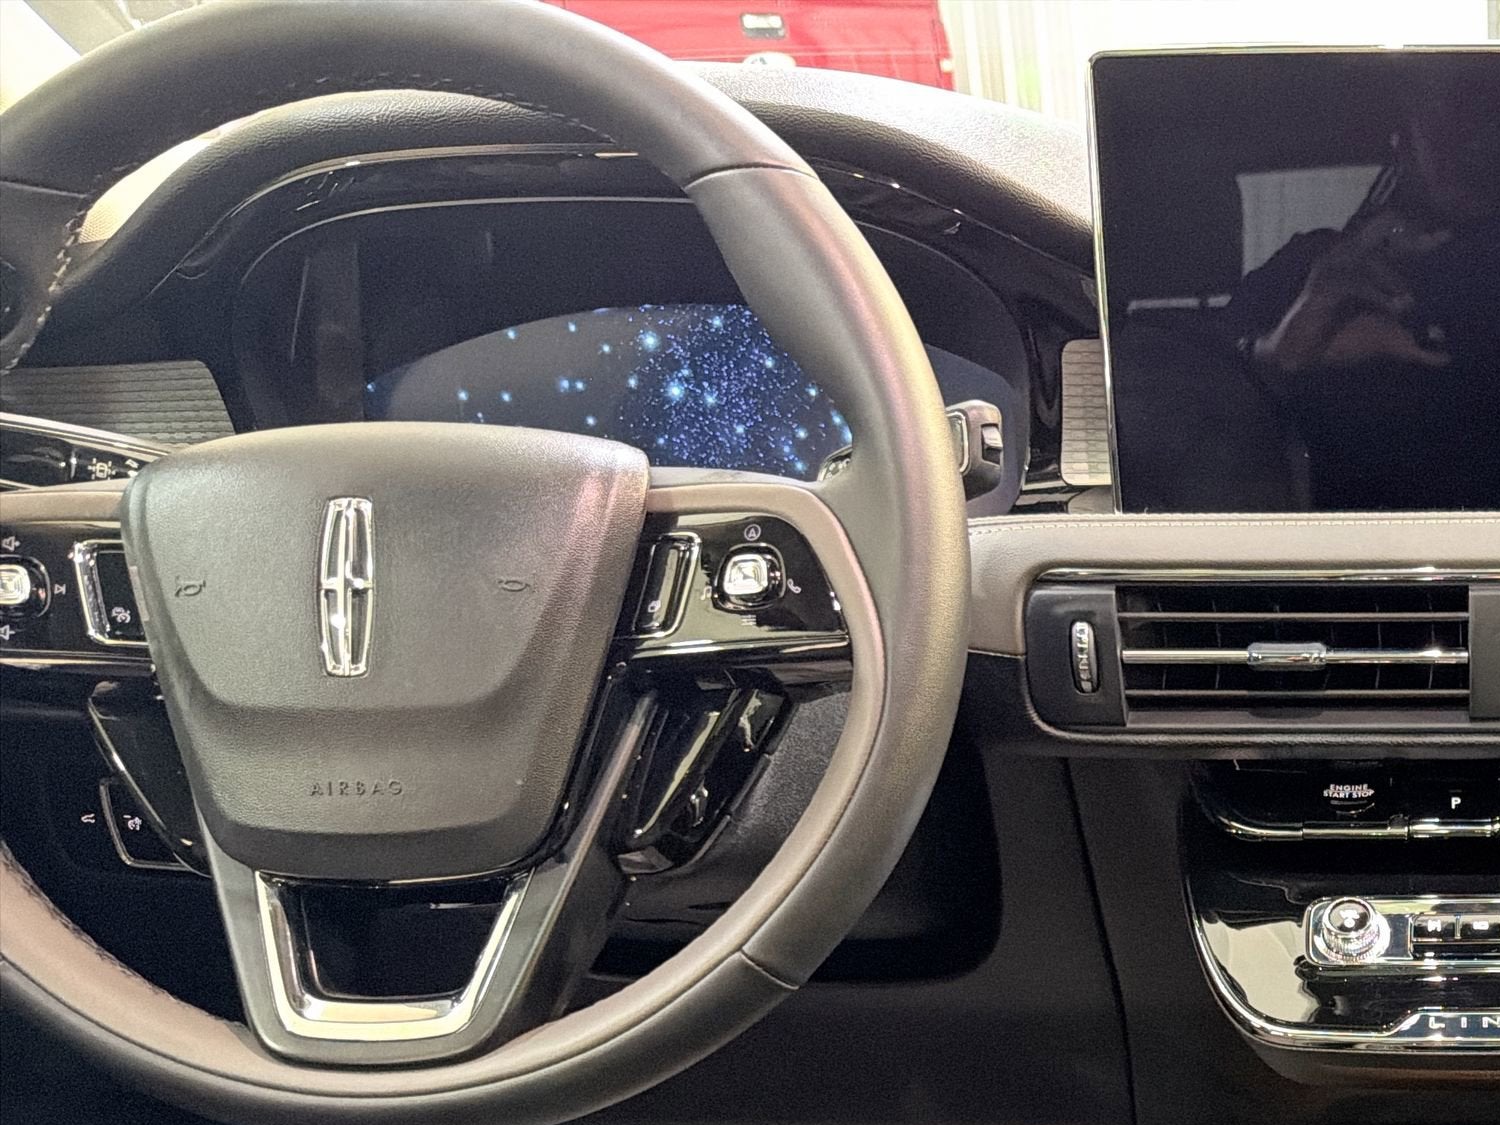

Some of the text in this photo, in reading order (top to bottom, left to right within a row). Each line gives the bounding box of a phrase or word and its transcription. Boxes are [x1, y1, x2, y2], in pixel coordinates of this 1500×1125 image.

[310, 780, 402, 796] AIRBAG
[1323, 789, 1375, 798] START STOP
[1451, 797, 1462, 809] P
